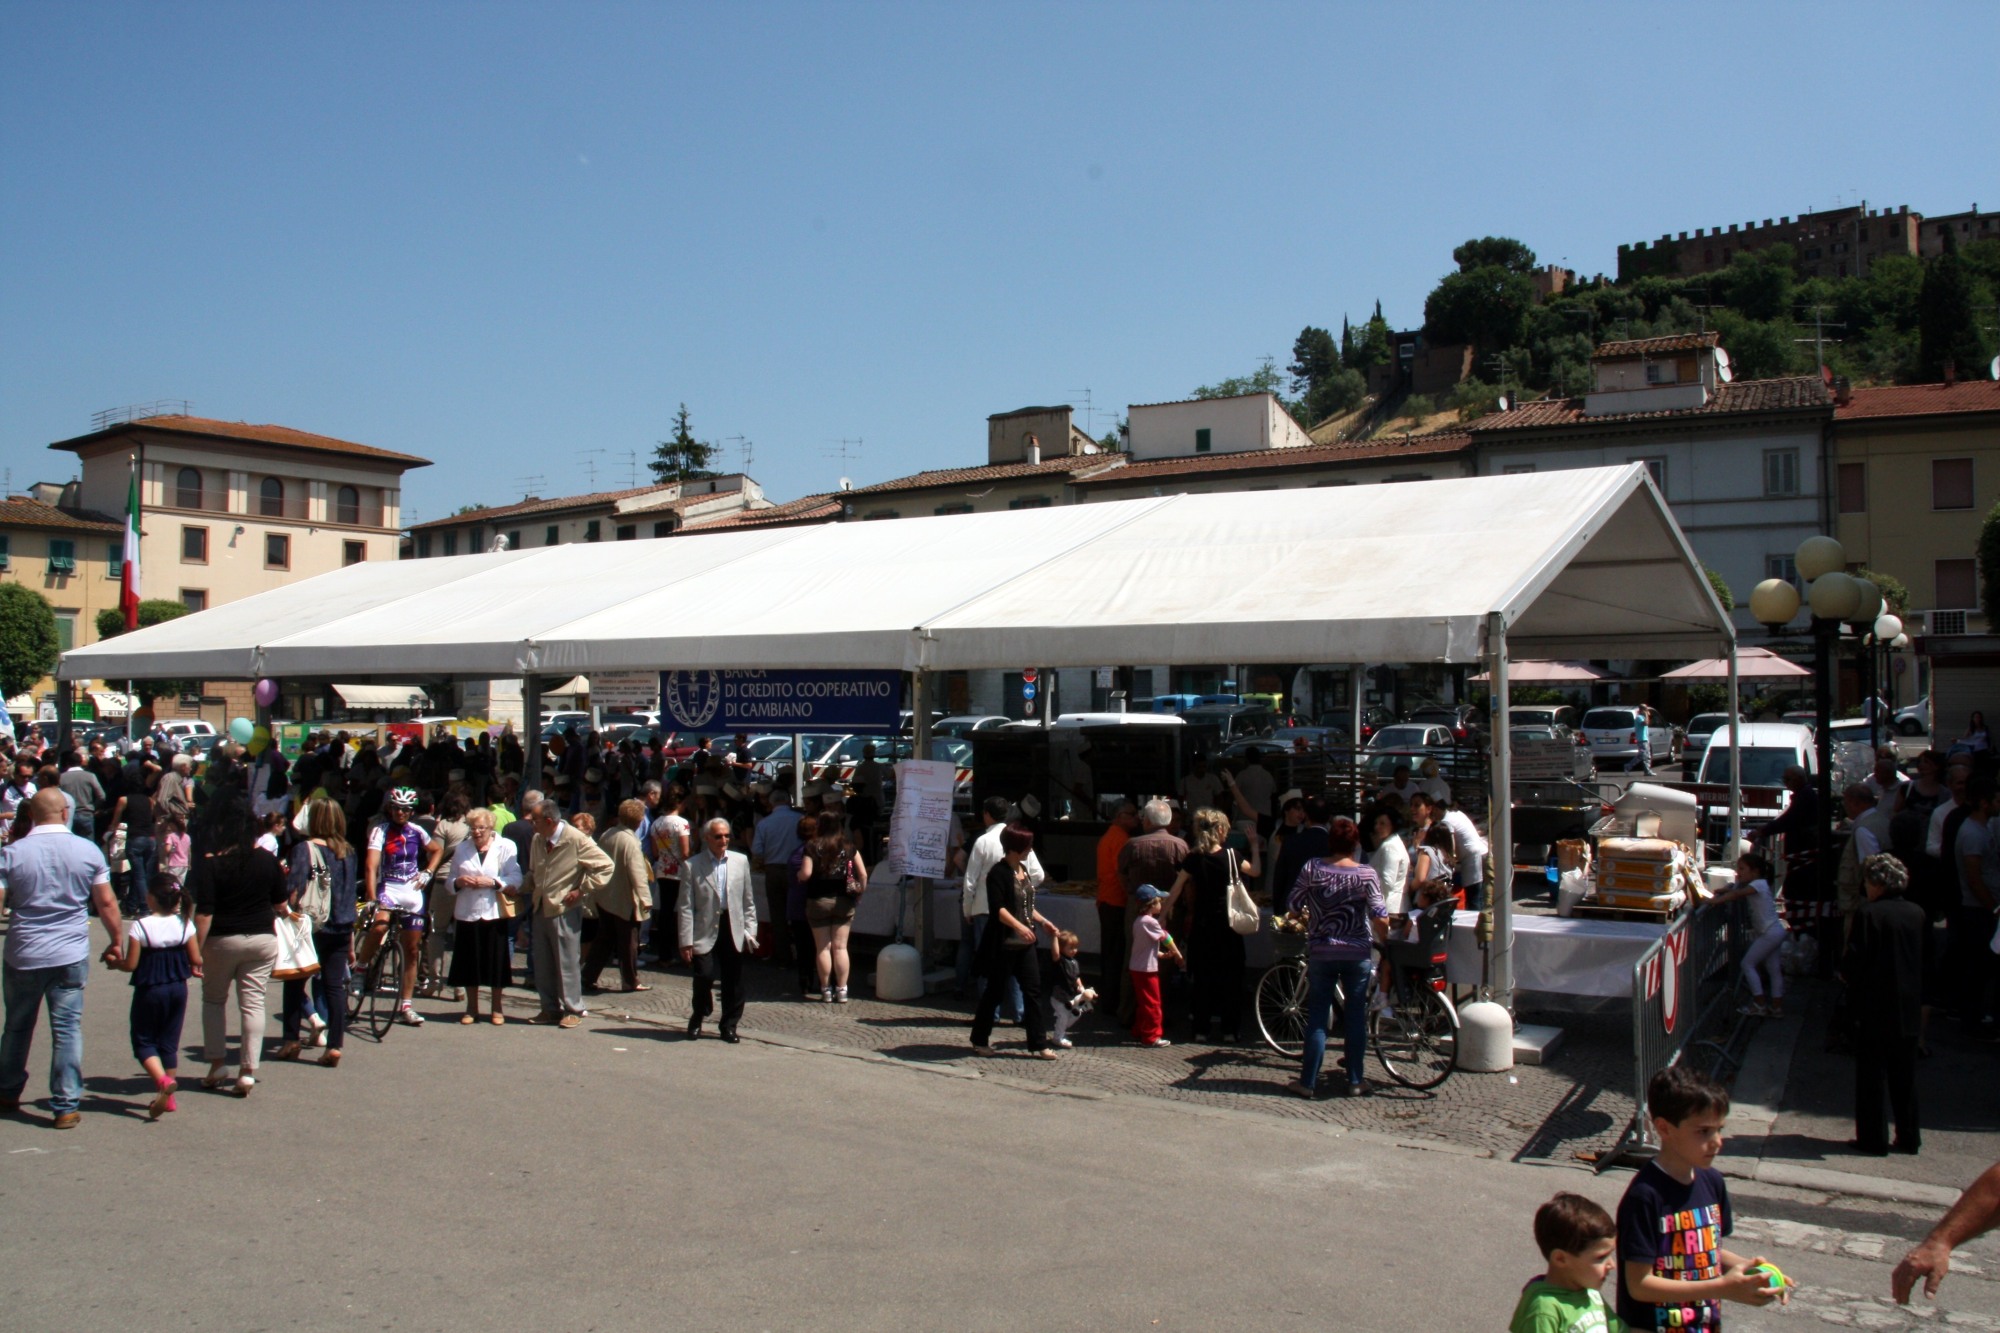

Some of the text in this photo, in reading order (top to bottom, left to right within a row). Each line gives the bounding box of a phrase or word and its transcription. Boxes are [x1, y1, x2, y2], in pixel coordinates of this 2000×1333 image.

[724, 669, 767, 679] BANCA
[725, 681, 891, 698] DI CREDITO COOPERATIVO
[725, 702, 813, 718] DI CAMBIANO
[1658, 1206, 1713, 1234] ORIGINAL
[1656, 1252, 1709, 1271] SUMMER
[1655, 1306, 1695, 1327] POP
